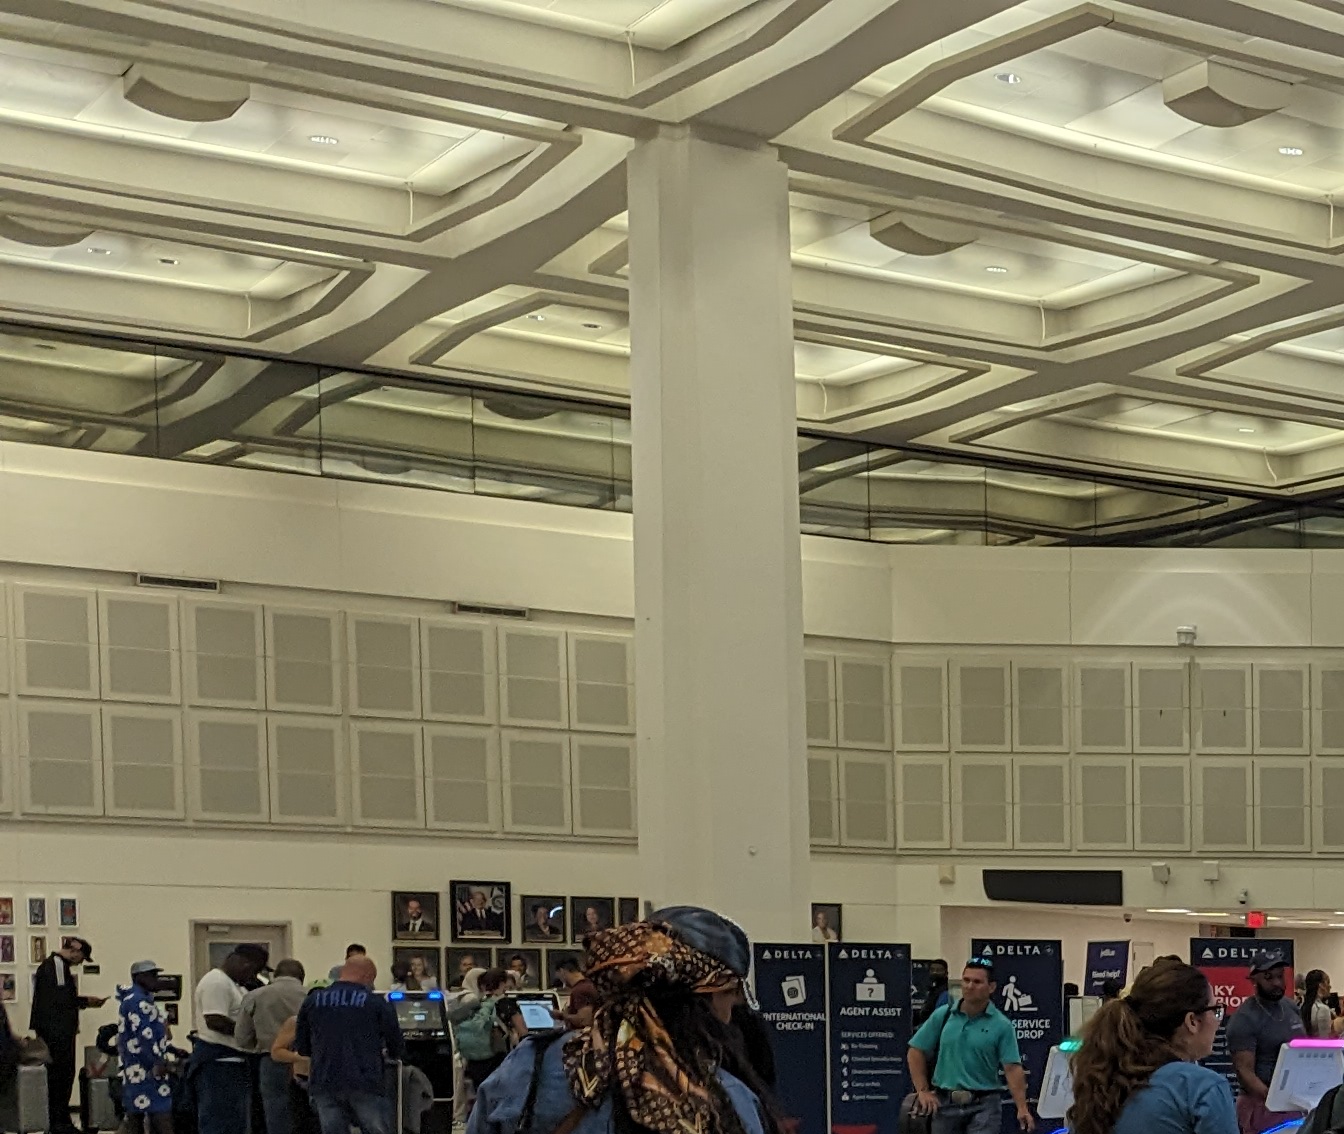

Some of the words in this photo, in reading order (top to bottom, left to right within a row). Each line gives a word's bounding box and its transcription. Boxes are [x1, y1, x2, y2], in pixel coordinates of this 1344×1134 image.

[775, 950, 812, 958] DELTA
[851, 950, 892, 959] DELTA
[996, 945, 1041, 955] DELTA
[1100, 948, 1116, 957] jetBlue
[1218, 948, 1267, 958] DELT
[1214, 986, 1234, 995] KY
[316, 990, 367, 1007] ITALIA
[840, 1007, 870, 1016] AGENT
[872, 1008, 902, 1016] ASSIST
[776, 1022, 814, 1030] CHECK-IN
[1012, 1019, 1050, 1028] SERVICE
[1017, 1030, 1043, 1039] DROP
